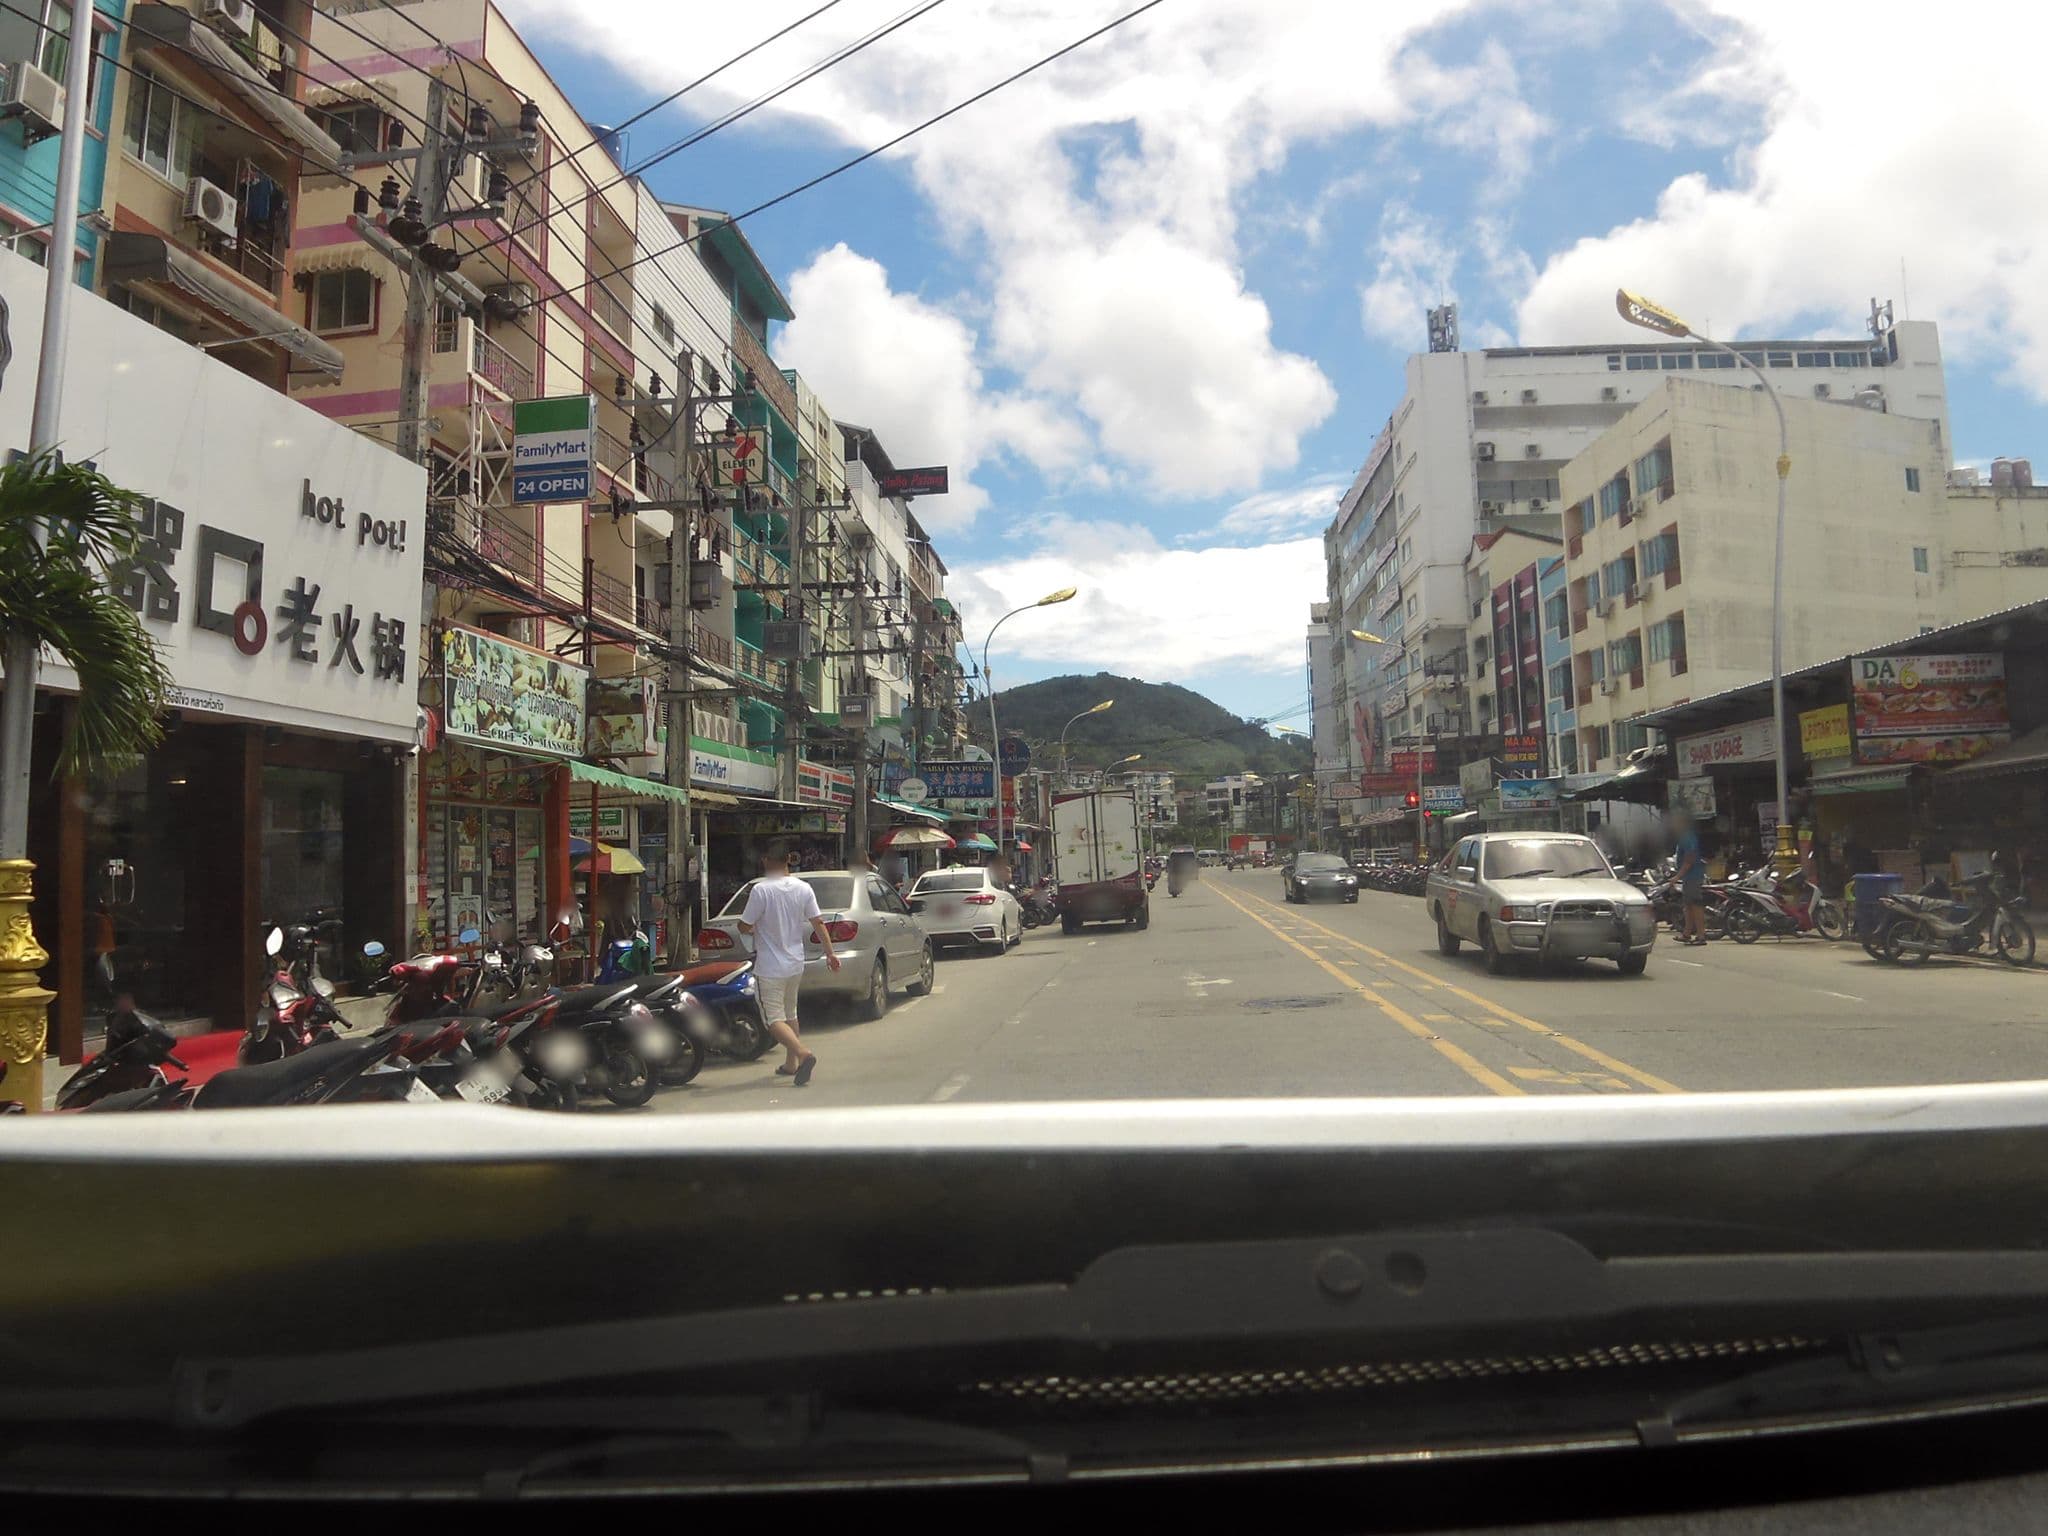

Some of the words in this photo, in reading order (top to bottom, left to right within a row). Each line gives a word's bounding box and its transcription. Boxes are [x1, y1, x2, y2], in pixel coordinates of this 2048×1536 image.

[515, 441, 586, 458] FamilyMart
[517, 481, 535, 494] 24
[538, 478, 585, 492] OPEN
[303, 478, 346, 528] hot
[1862, 660, 1895, 679] DA
[1899, 661, 1920, 689] 6
[694, 756, 727, 781] FamilyMart
